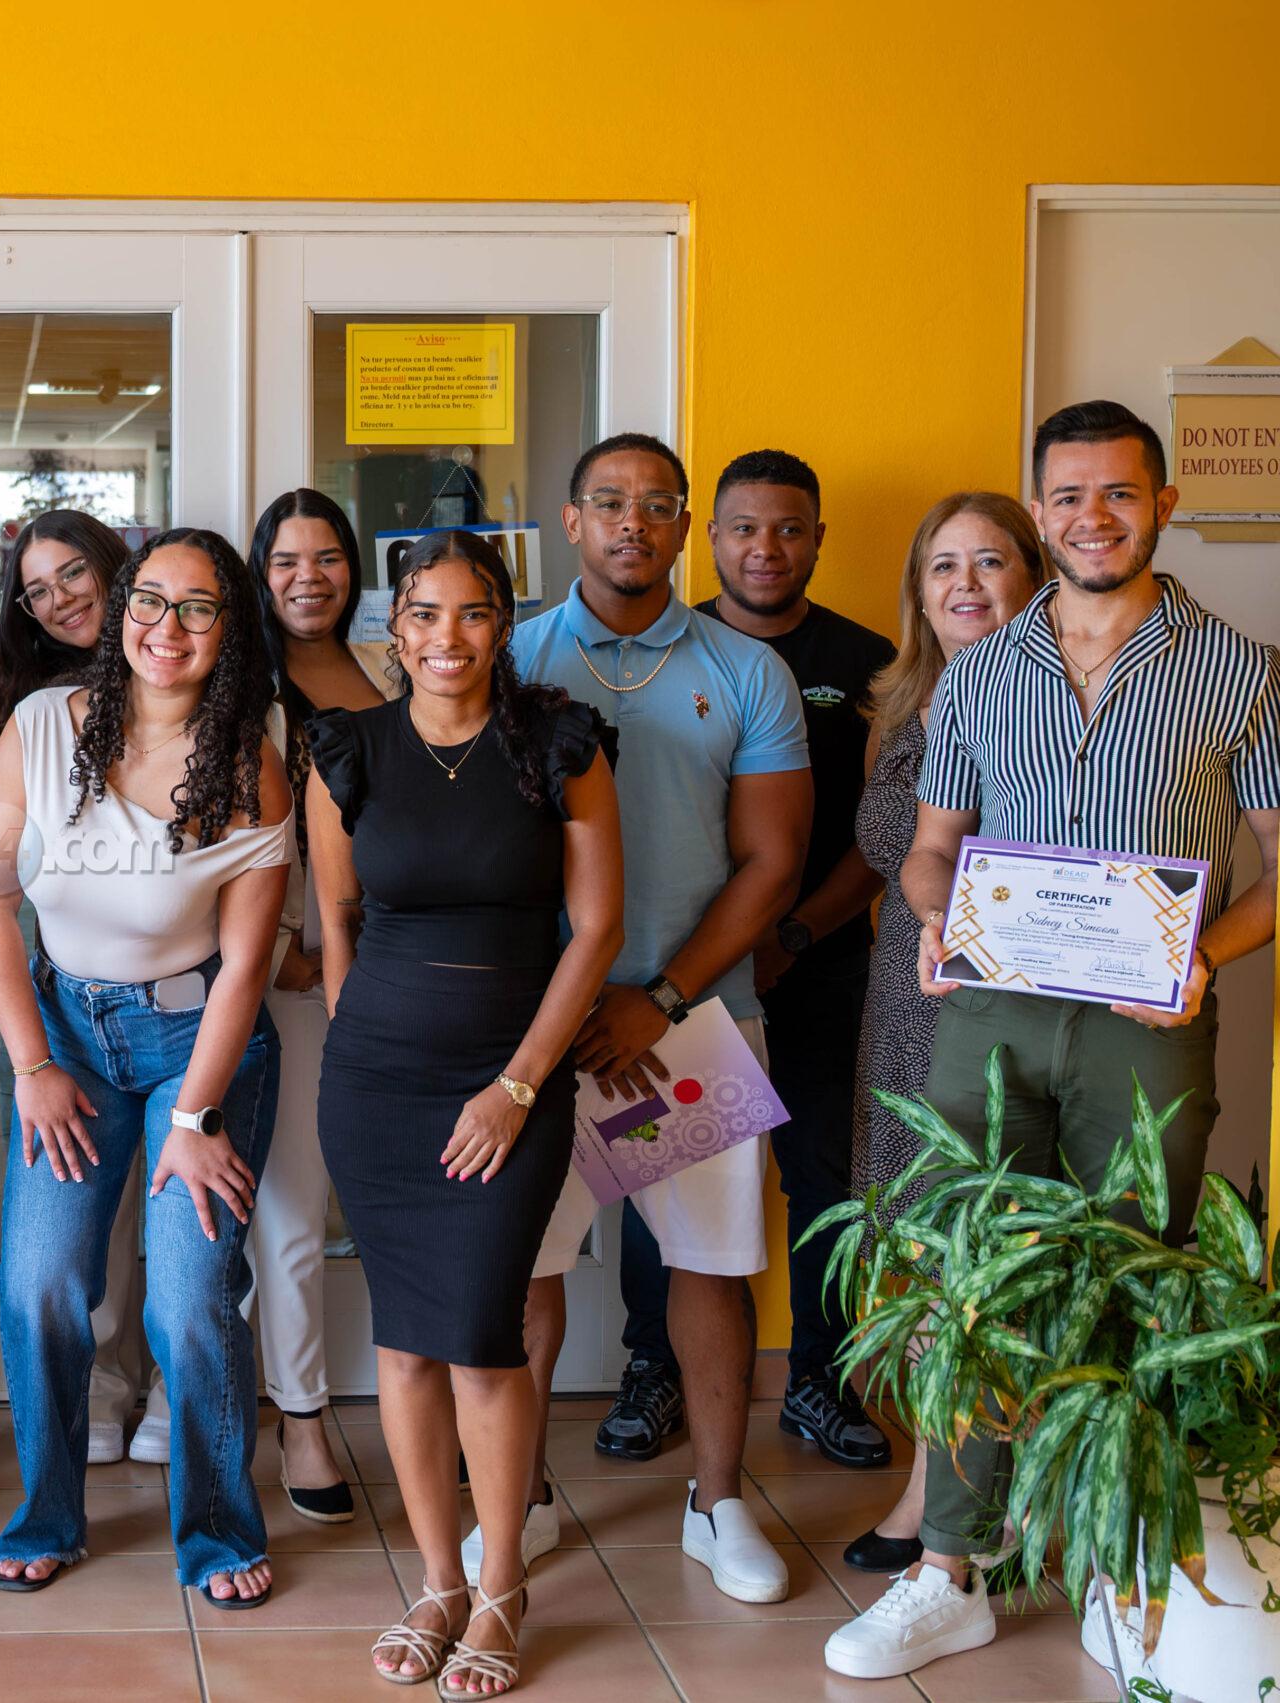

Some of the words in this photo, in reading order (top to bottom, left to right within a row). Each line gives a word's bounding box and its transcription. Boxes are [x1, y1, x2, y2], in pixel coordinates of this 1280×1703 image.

[1182, 427, 1207, 447] DO
[1212, 427, 1250, 447] NOT
[1181, 458, 1264, 475] EMPLOYEES
[1268, 458, 1280, 475] O
[1036, 890, 1112, 906] CERTIFICATE
[1056, 902, 1096, 911] PARTICIPATION
[1018, 911, 1062, 931] Sidney
